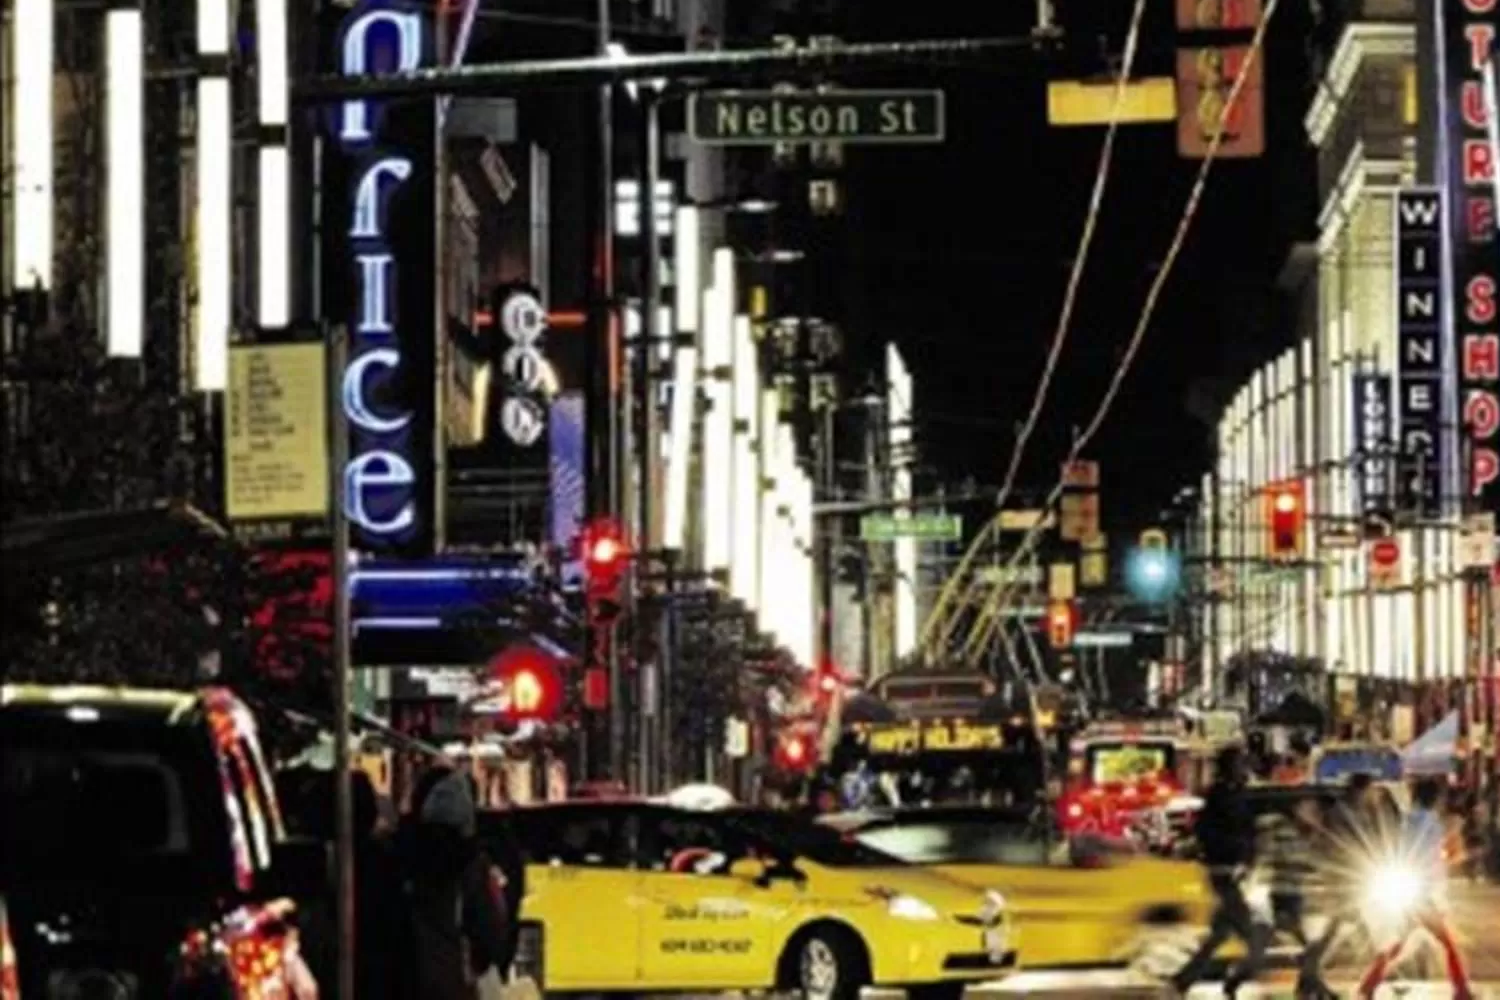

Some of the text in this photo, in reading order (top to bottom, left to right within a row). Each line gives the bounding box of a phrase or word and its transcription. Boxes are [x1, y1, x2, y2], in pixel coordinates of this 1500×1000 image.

[716, 100, 917, 135] Nelson St
[1463, 275, 1500, 497] SHOP
